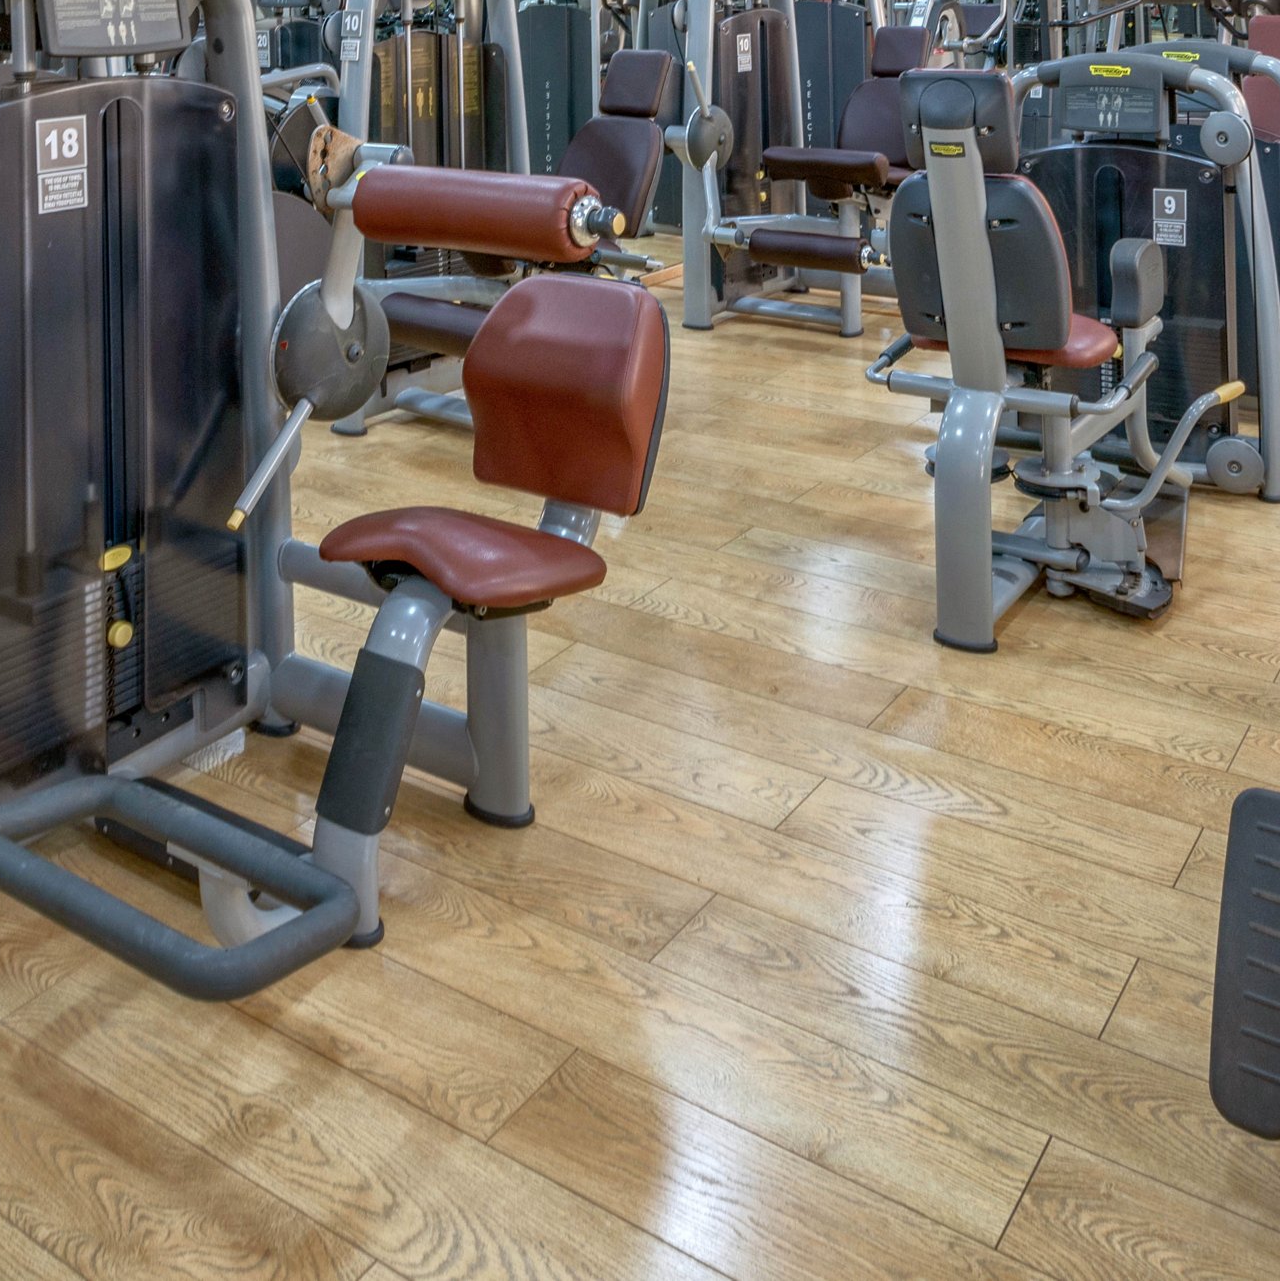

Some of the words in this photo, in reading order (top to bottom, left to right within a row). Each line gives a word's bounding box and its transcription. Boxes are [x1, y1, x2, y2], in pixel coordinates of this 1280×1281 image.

[915, 6, 925, 15] 27
[344, 14, 359, 31] 10
[258, 34, 267, 47] 20
[739, 39, 749, 52] 10
[45, 128, 79, 160] 18
[1164, 196, 1176, 215] 9
